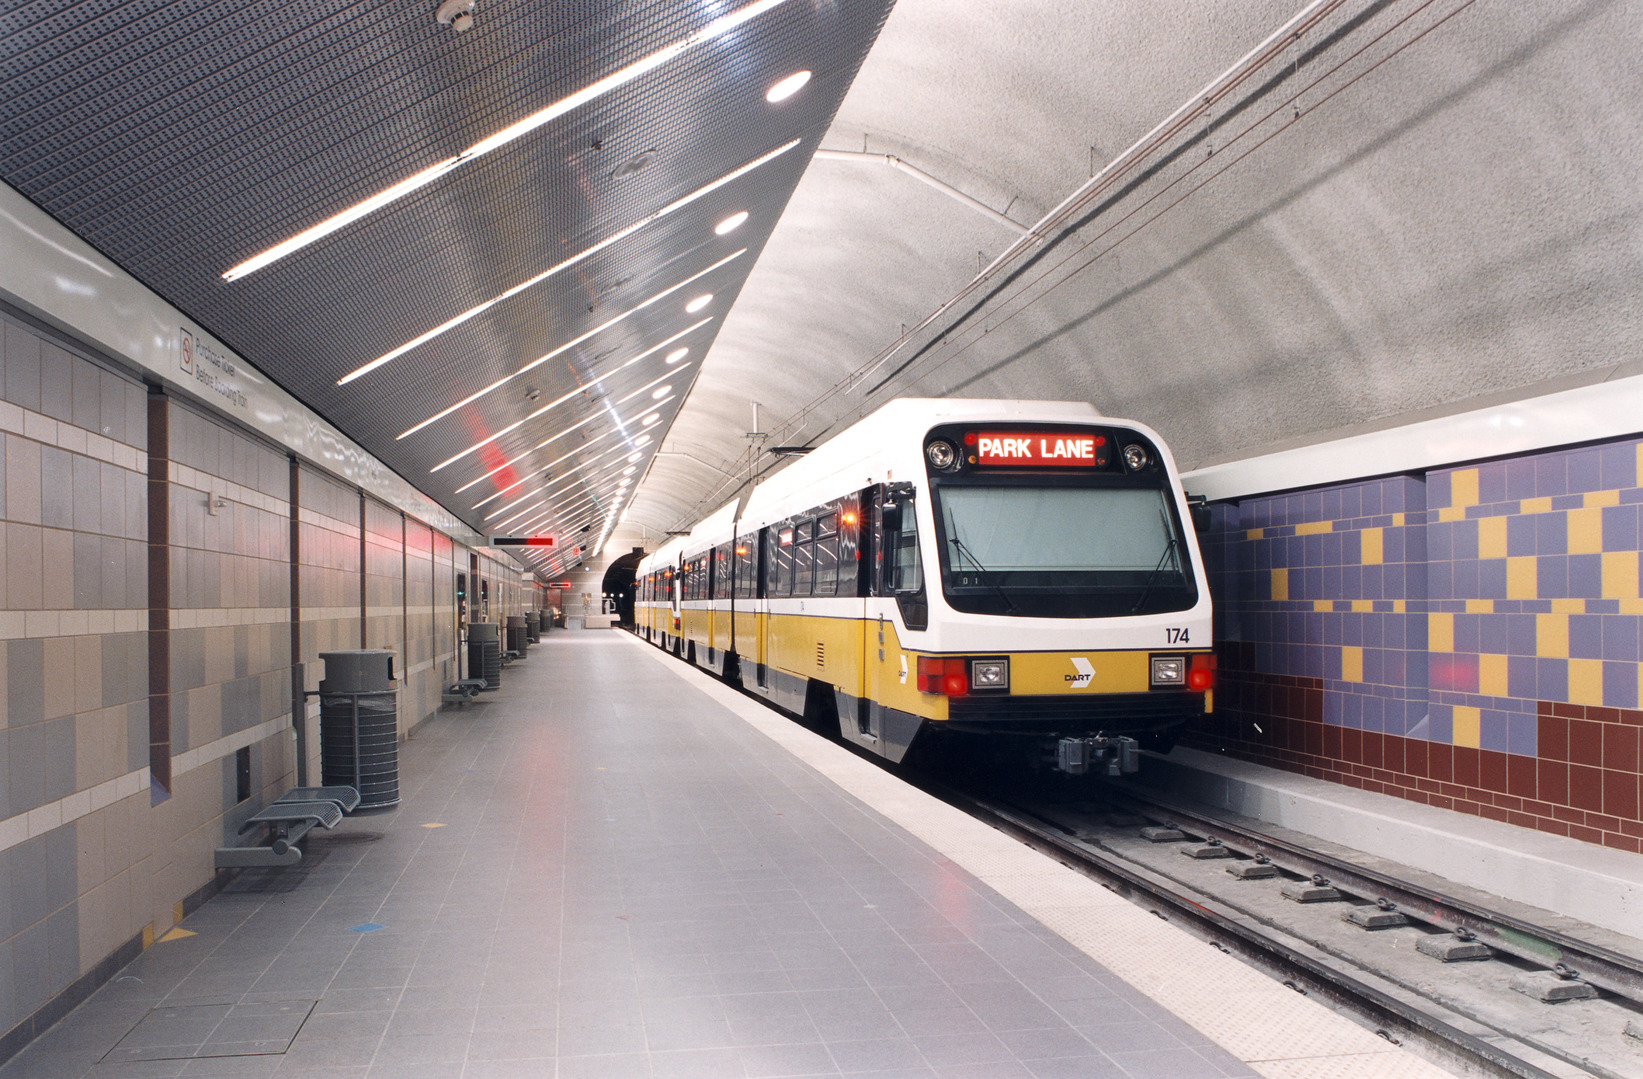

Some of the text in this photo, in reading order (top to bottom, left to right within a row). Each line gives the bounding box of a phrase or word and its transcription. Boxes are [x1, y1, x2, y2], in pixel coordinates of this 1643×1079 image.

[196, 363, 214, 389] Before
[979, 438, 1094, 459] PARK LANE
[1166, 627, 1190, 644] 174
[1064, 674, 1092, 682] DART
